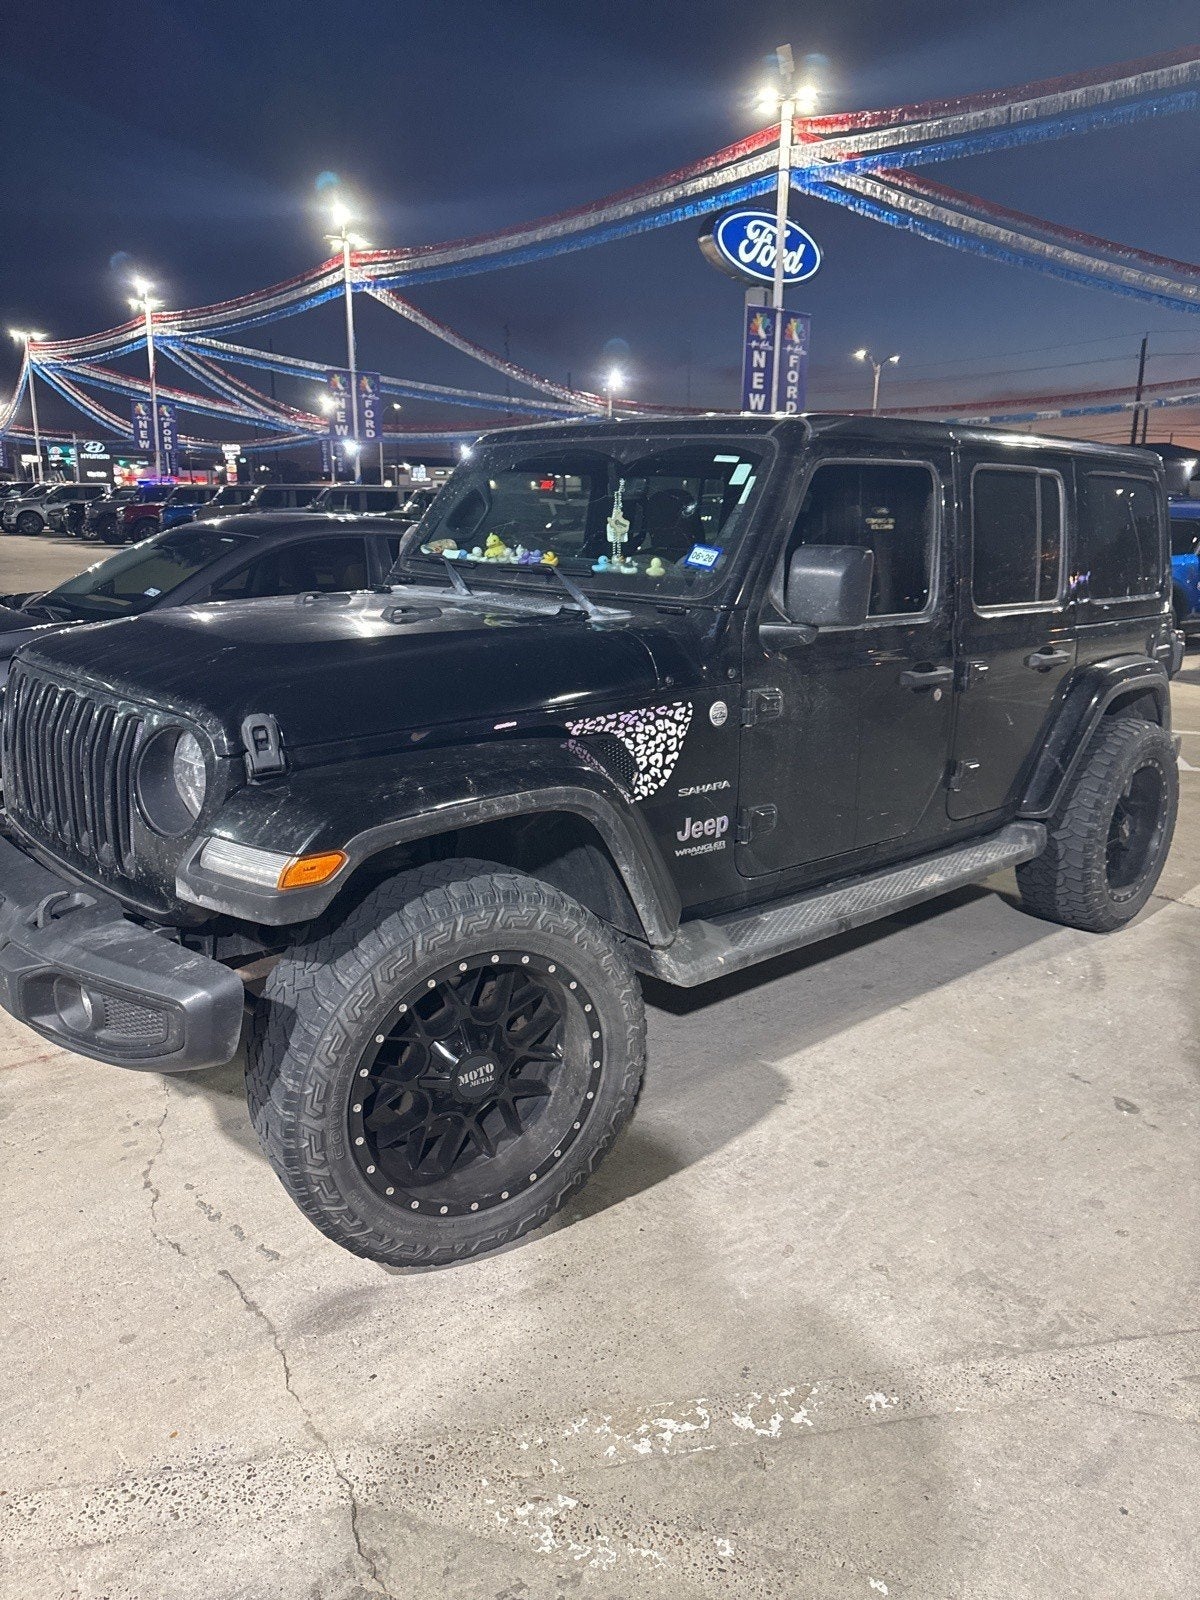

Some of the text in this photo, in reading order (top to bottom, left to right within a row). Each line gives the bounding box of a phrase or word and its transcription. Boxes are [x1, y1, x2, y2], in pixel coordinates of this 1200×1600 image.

[749, 350, 766, 411] NEW
[786, 355, 799, 413] FORD
[365, 400, 376, 438] FORD
[138, 420, 150, 449] NEW
[162, 421, 173, 450] FORD
[678, 780, 730, 797] SAHARA
[676, 815, 729, 842] Jeep
[674, 840, 726, 857] WRANGLER
[458, 1063, 494, 1086] MOTO
[470, 1075, 494, 1087] METAL
